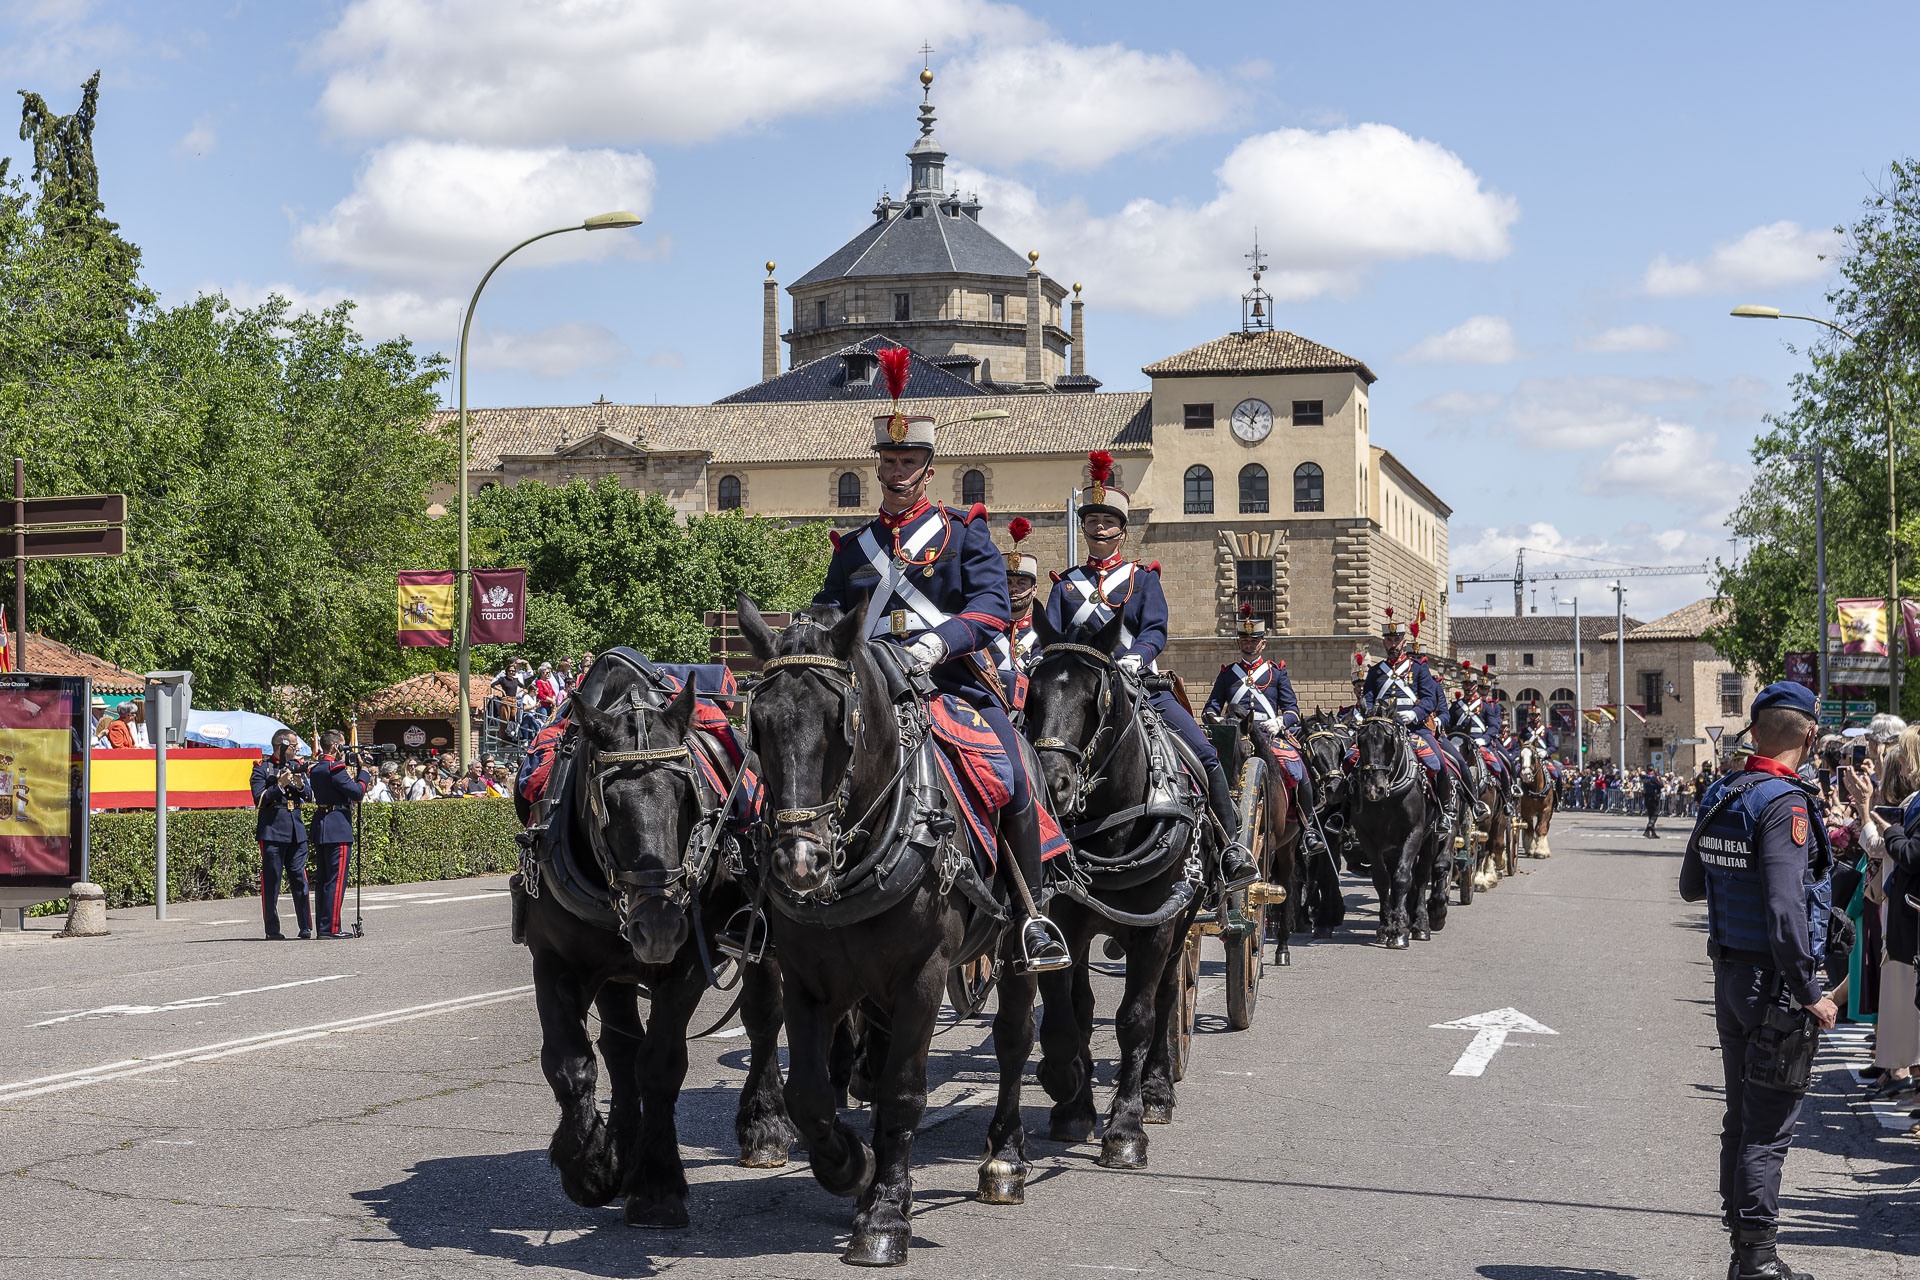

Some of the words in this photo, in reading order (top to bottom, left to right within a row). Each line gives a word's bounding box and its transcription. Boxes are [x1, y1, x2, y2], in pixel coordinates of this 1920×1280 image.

[481, 612, 514, 620] TOLEDO
[1699, 836, 1722, 851] UARDIA
[1724, 840, 1751, 853] REAL
[1716, 856, 1747, 868] MILITAR
